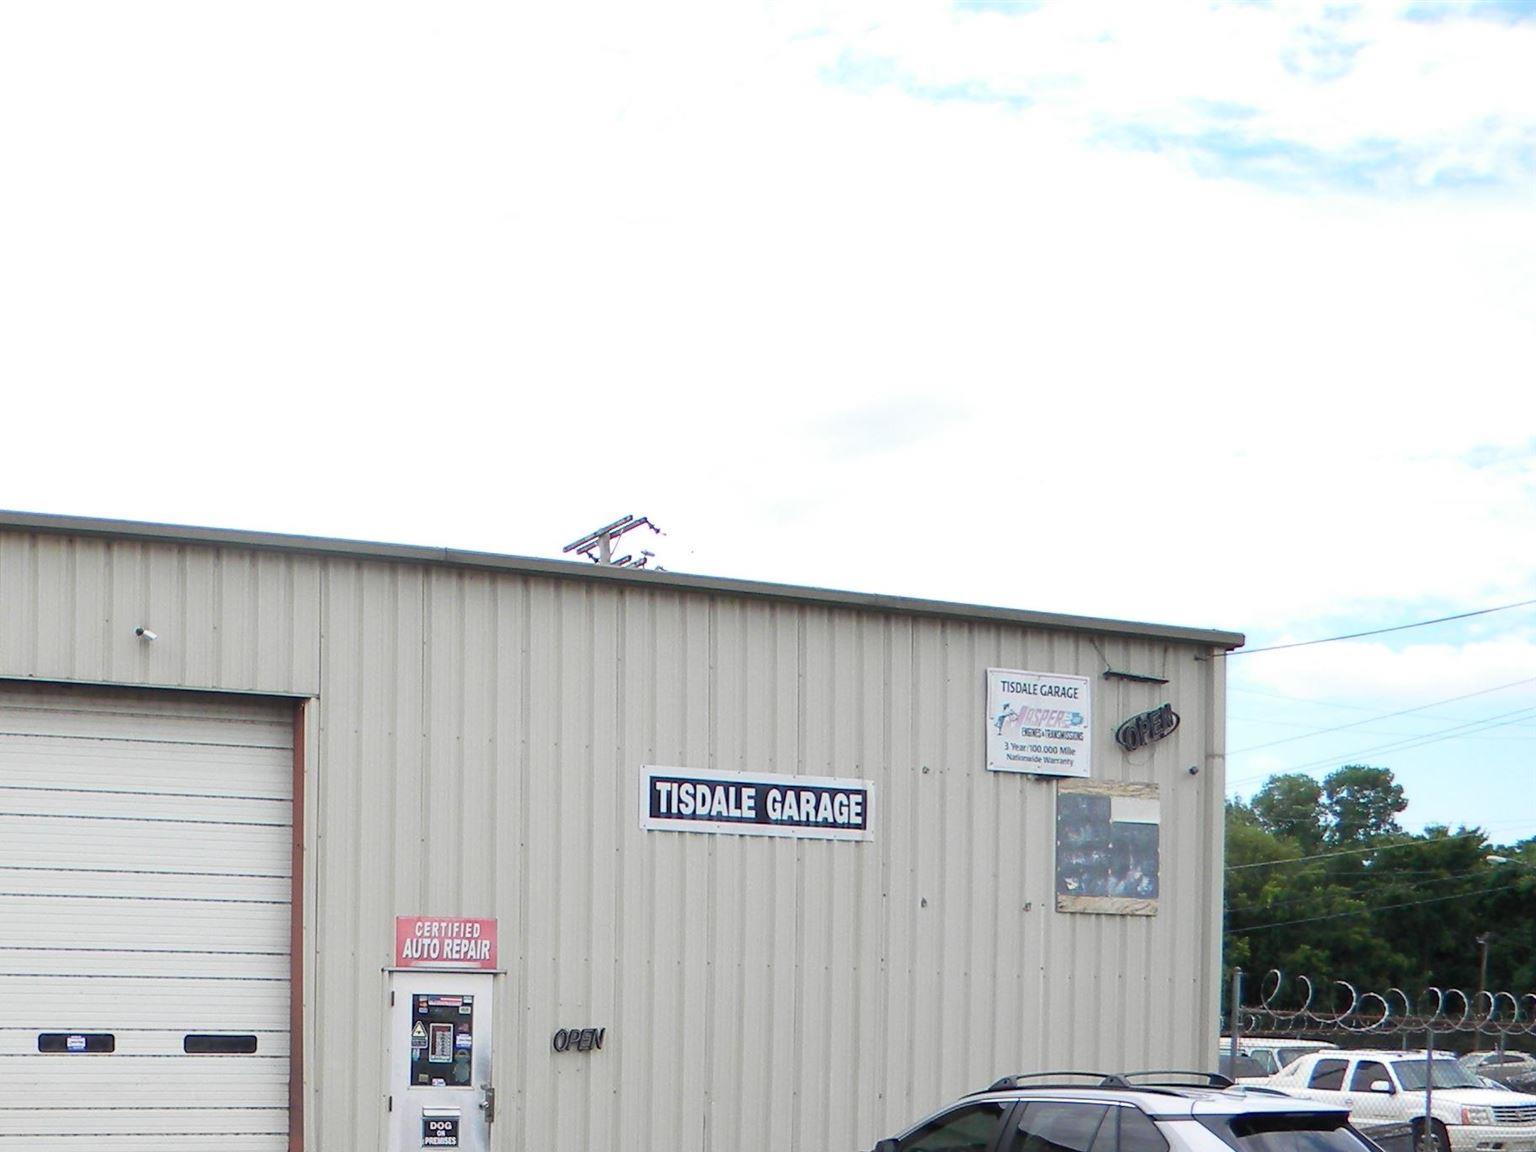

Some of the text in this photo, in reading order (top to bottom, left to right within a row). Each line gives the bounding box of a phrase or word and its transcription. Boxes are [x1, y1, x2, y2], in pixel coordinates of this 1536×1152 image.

[1001, 680, 1079, 700] TISDALE GARAGE
[1122, 703, 1174, 752] OPEN
[655, 781, 863, 825] TISDALE GARAGE
[415, 921, 481, 938] CERTIFIED
[402, 938, 491, 960] AUTO REPAIR
[553, 1027, 606, 1053] OPEN
[429, 1121, 453, 1130] DOG
[424, 1136, 457, 1145] PREMISES
